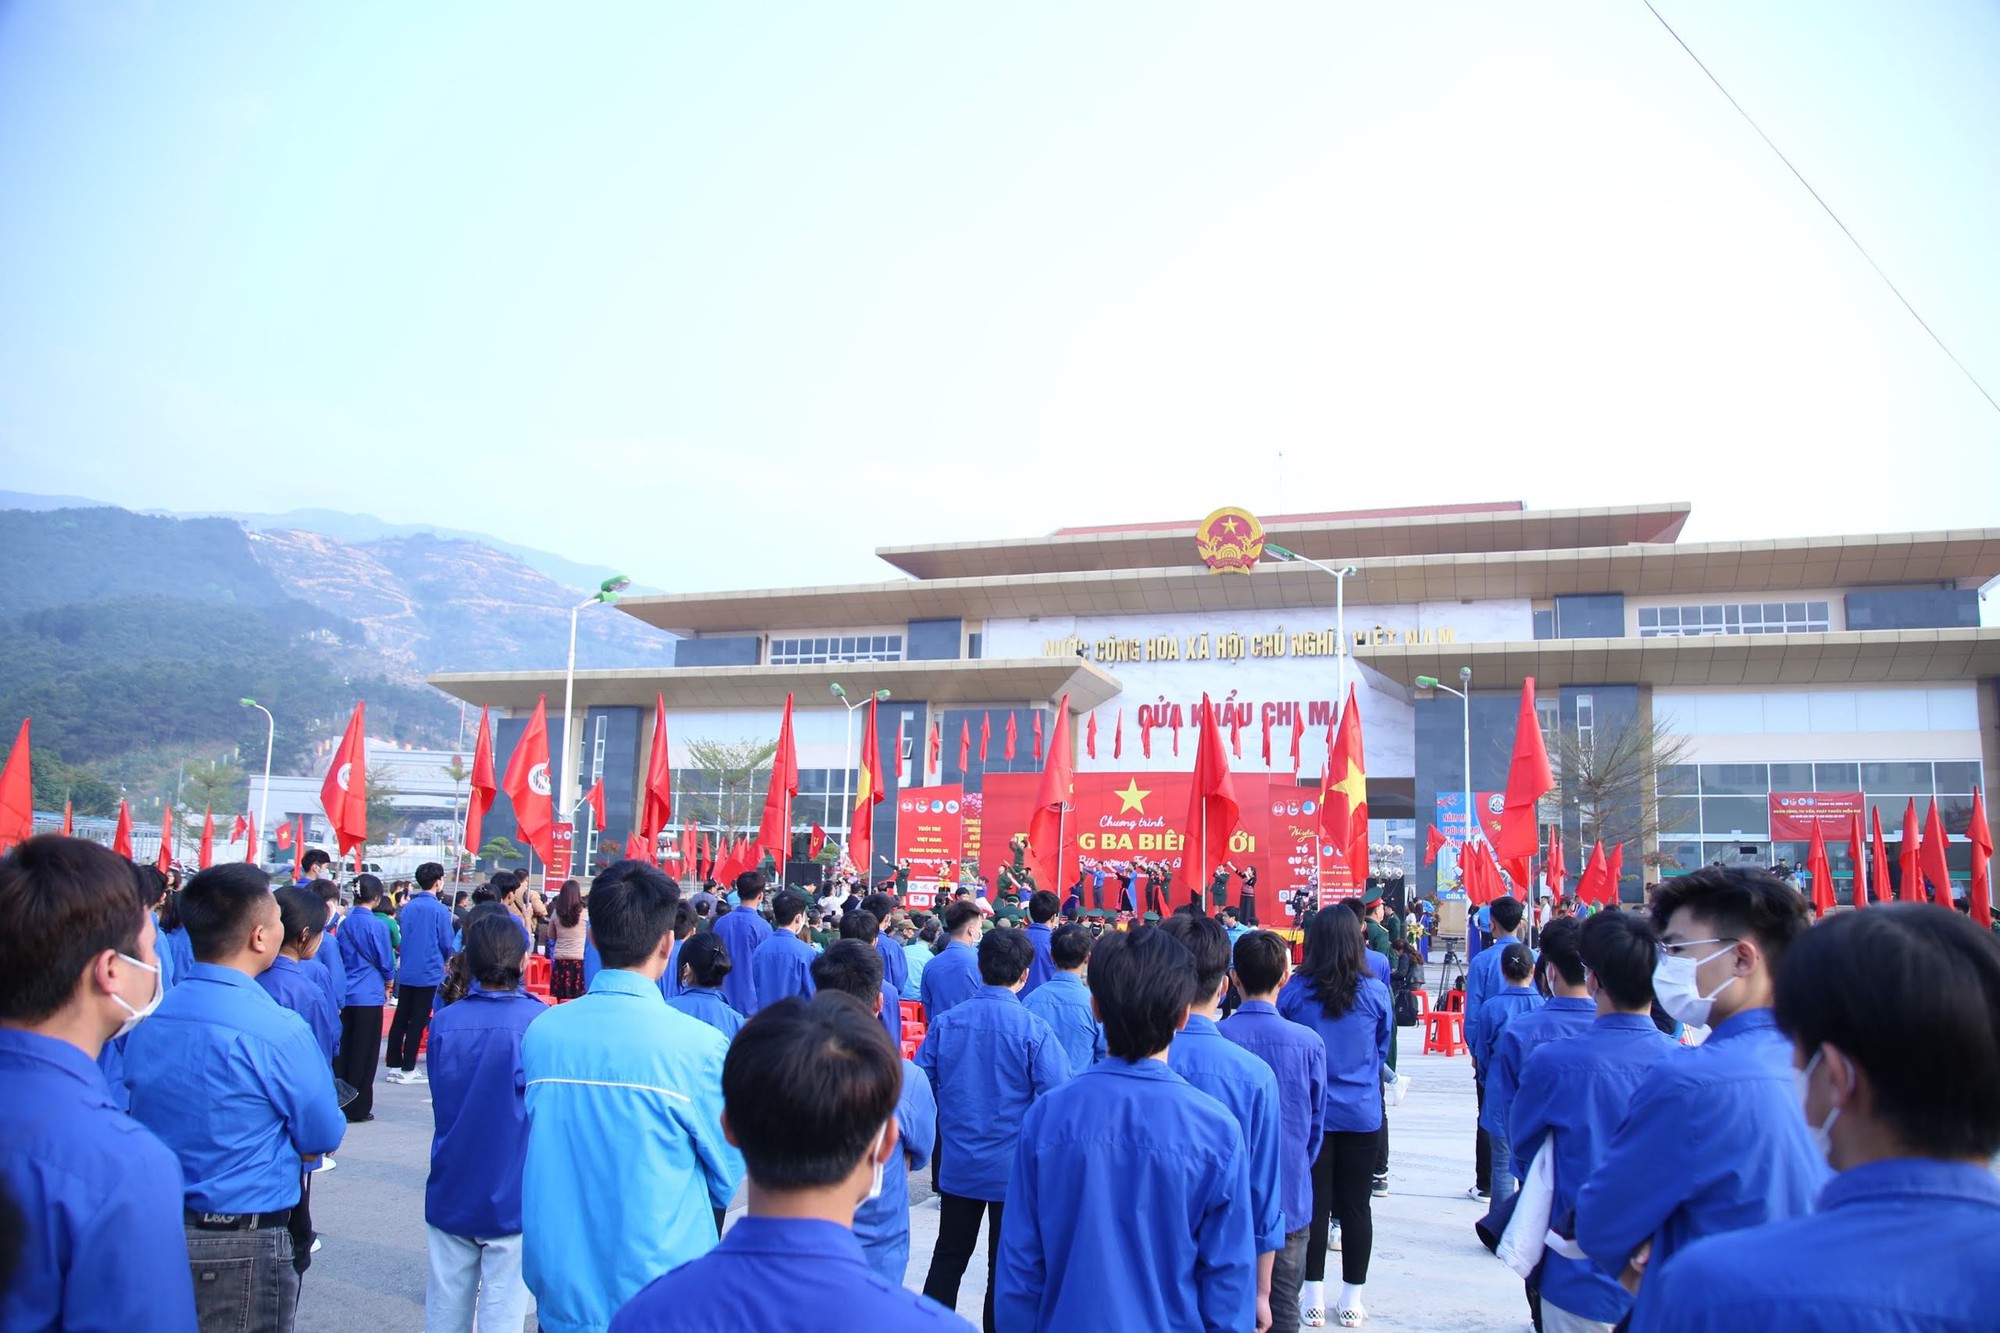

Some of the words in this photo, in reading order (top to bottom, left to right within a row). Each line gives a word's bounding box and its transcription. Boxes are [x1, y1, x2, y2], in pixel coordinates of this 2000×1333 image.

[1094, 634, 1141, 668] CỘNG
[1184, 631, 1211, 660] XÃ
[1215, 629, 1246, 664] HỘI
[1249, 625, 1286, 658] CHỦ
[1099, 815, 1137, 830] Chương
[1136, 815, 1165, 828] trình
[1101, 833, 1134, 851] BA
